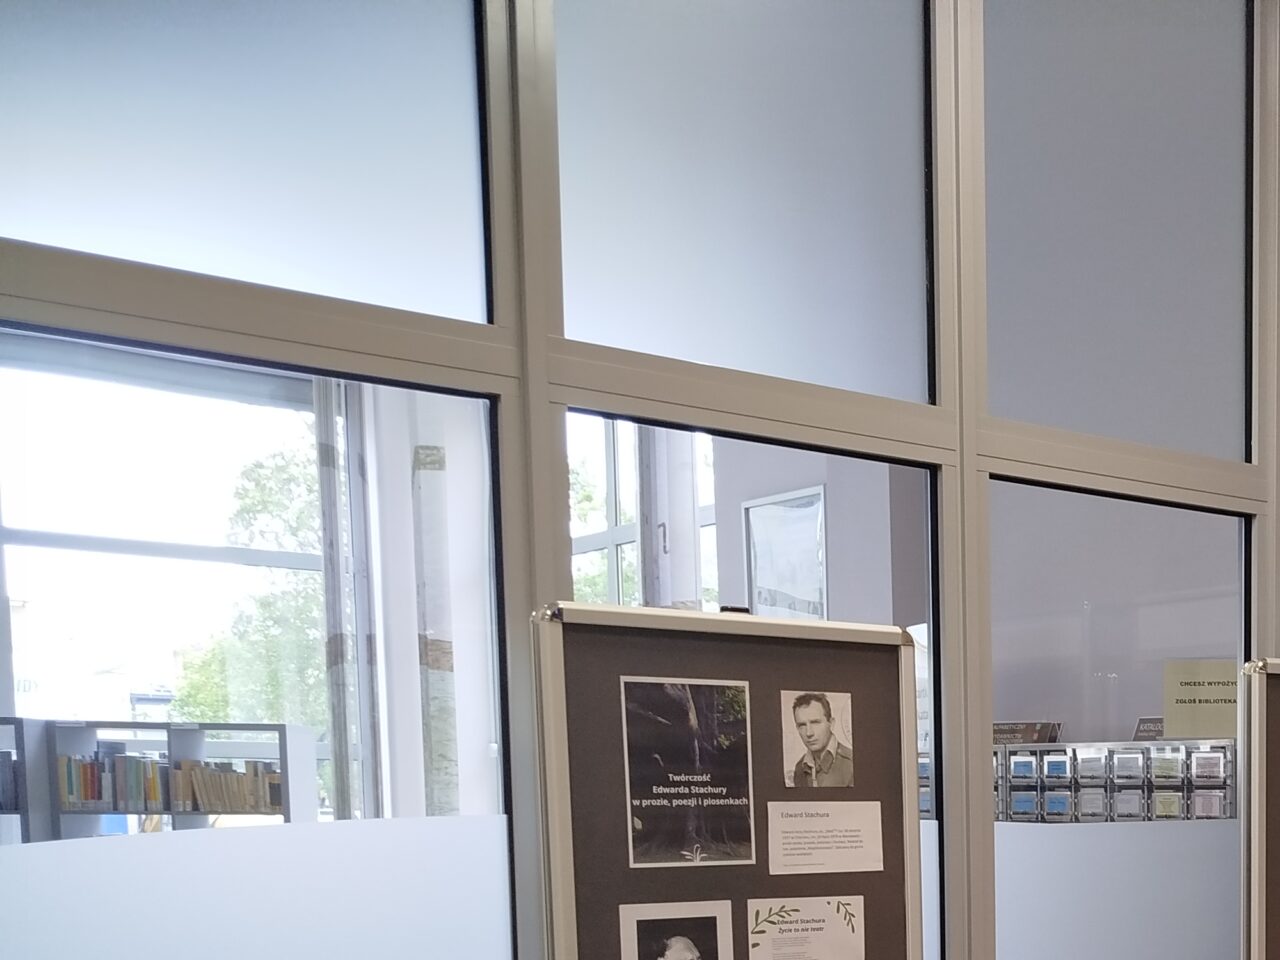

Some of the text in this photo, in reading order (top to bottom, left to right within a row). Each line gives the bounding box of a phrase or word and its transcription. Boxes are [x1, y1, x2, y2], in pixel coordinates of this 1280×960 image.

[667, 773, 712, 782] Twórczość
[653, 785, 727, 795] Edwarda Stachury
[641, 797, 671, 807] prozie,
[672, 797, 697, 807] poezji
[703, 797, 749, 807] piosenkach
